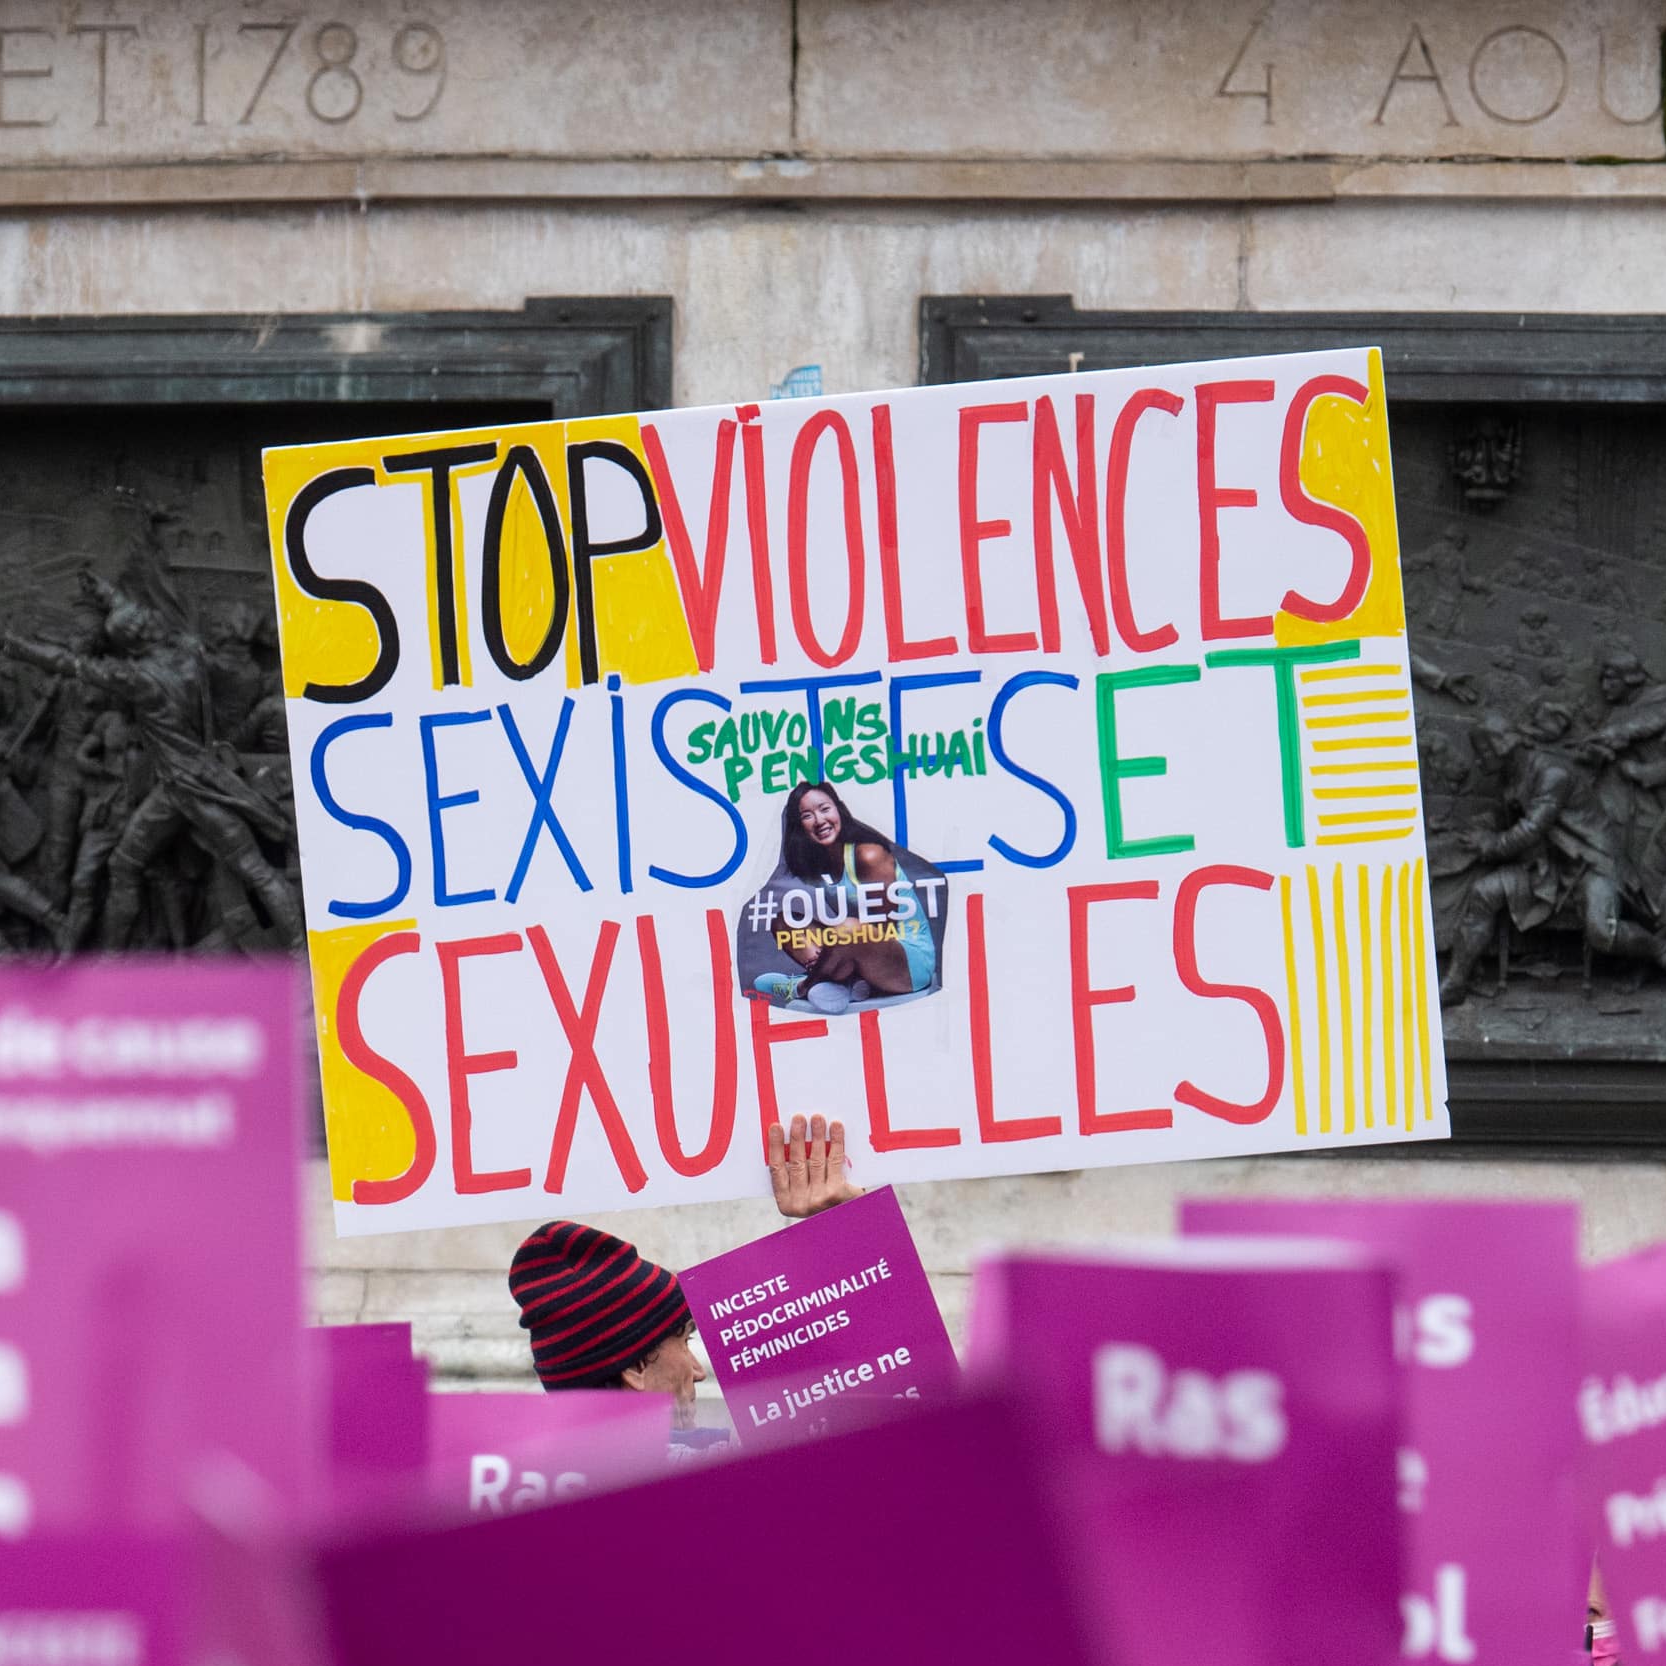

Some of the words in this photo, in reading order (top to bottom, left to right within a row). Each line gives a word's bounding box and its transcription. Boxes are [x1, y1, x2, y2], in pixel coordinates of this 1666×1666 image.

[191, 23, 449, 126] 1789
[1214, 18, 1277, 126] 4
[285, 438, 664, 704] STOP
[1096, 639, 1361, 861] ET
[858, 876, 946, 924] EST
[709, 1274, 790, 1320] INCESTE
[719, 1258, 893, 1347] PÉDOCRIMINALITÉ
[729, 1310, 851, 1373] FÉMINICIDES
[748, 1401, 782, 1428] La
[783, 1362, 875, 1420] justice
[876, 1346, 912, 1375] ne
[1092, 1341, 1285, 1461] Ras
